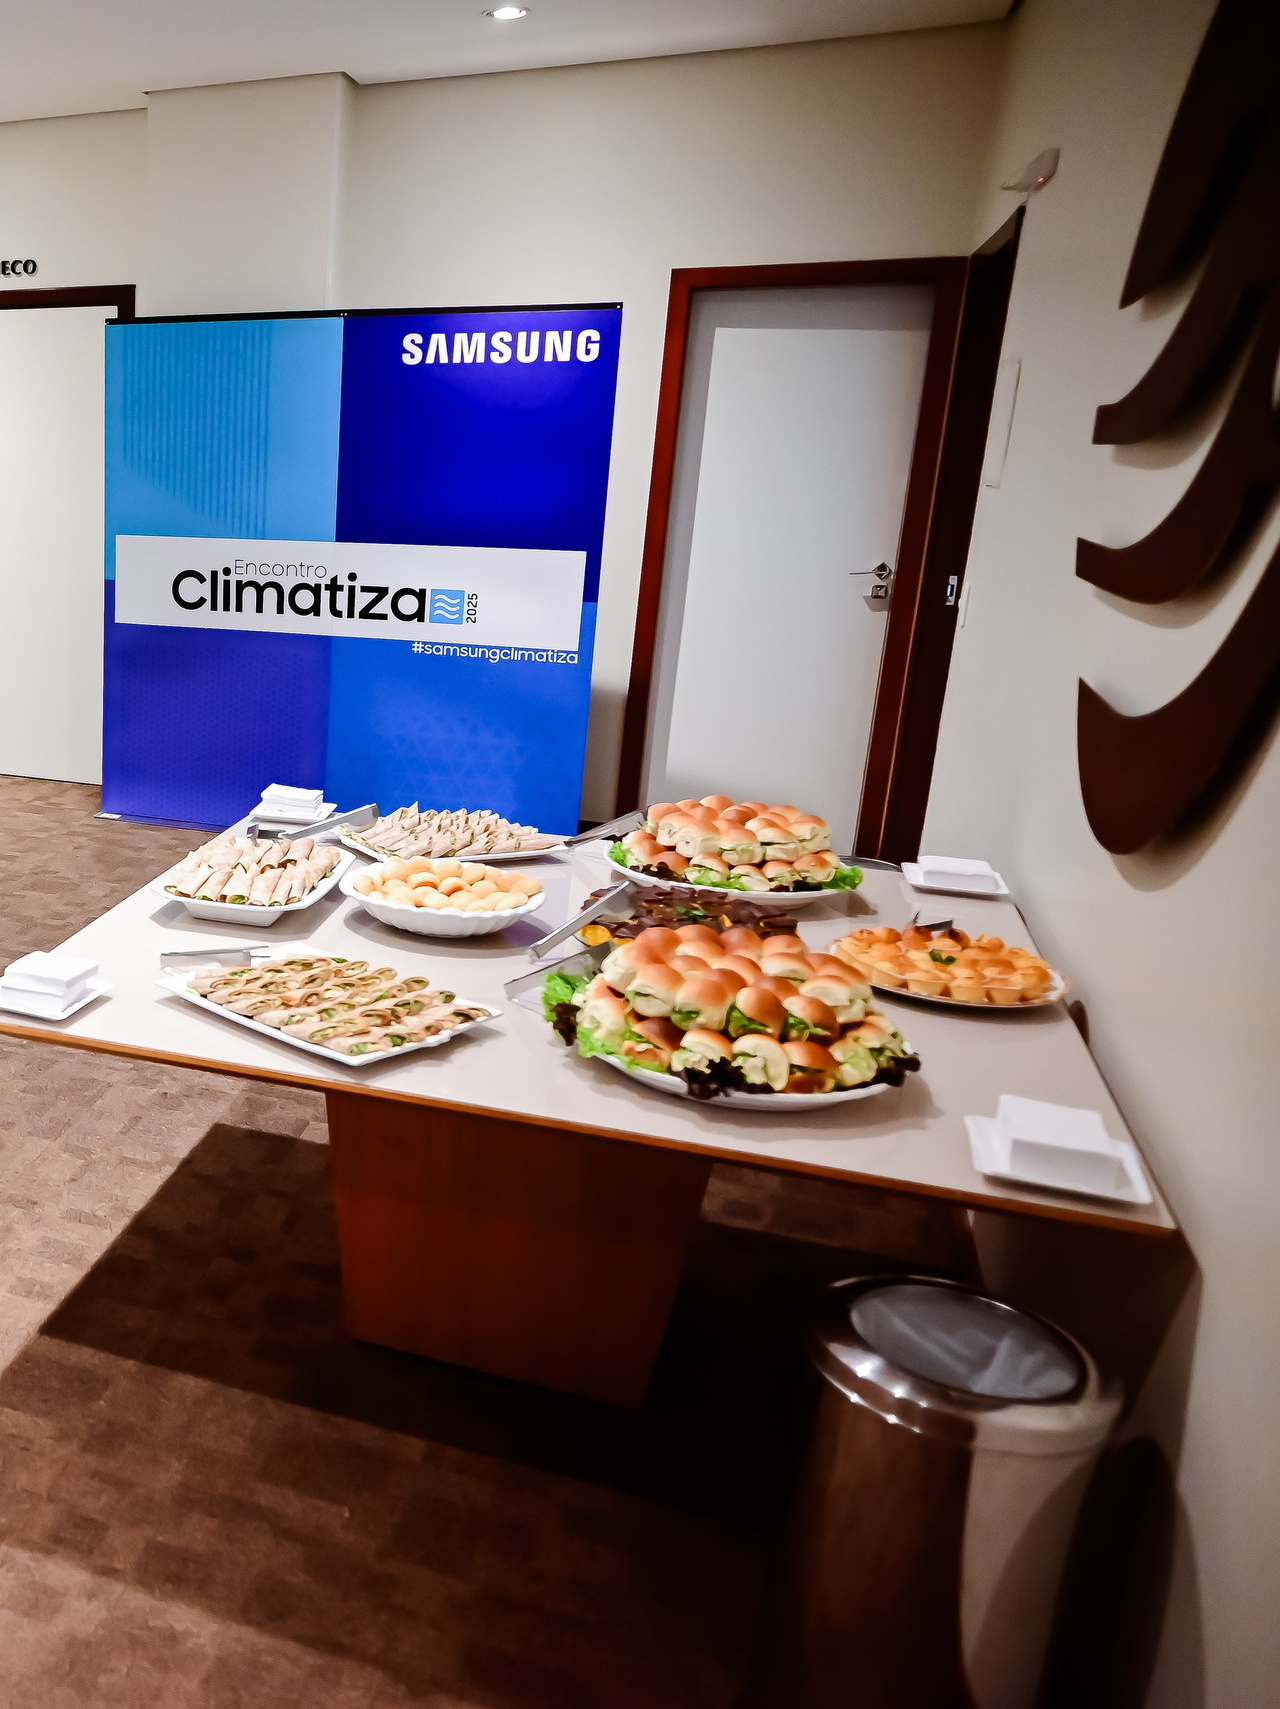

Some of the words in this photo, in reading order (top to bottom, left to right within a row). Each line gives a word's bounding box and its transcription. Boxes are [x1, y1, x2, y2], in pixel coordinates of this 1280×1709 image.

[402, 329, 600, 366] SAMSUNG
[234, 559, 328, 579] Encontro
[171, 566, 427, 623] Climatiza
[466, 592, 479, 624] 2025
[412, 641, 579, 665] #samsungclimatiza
